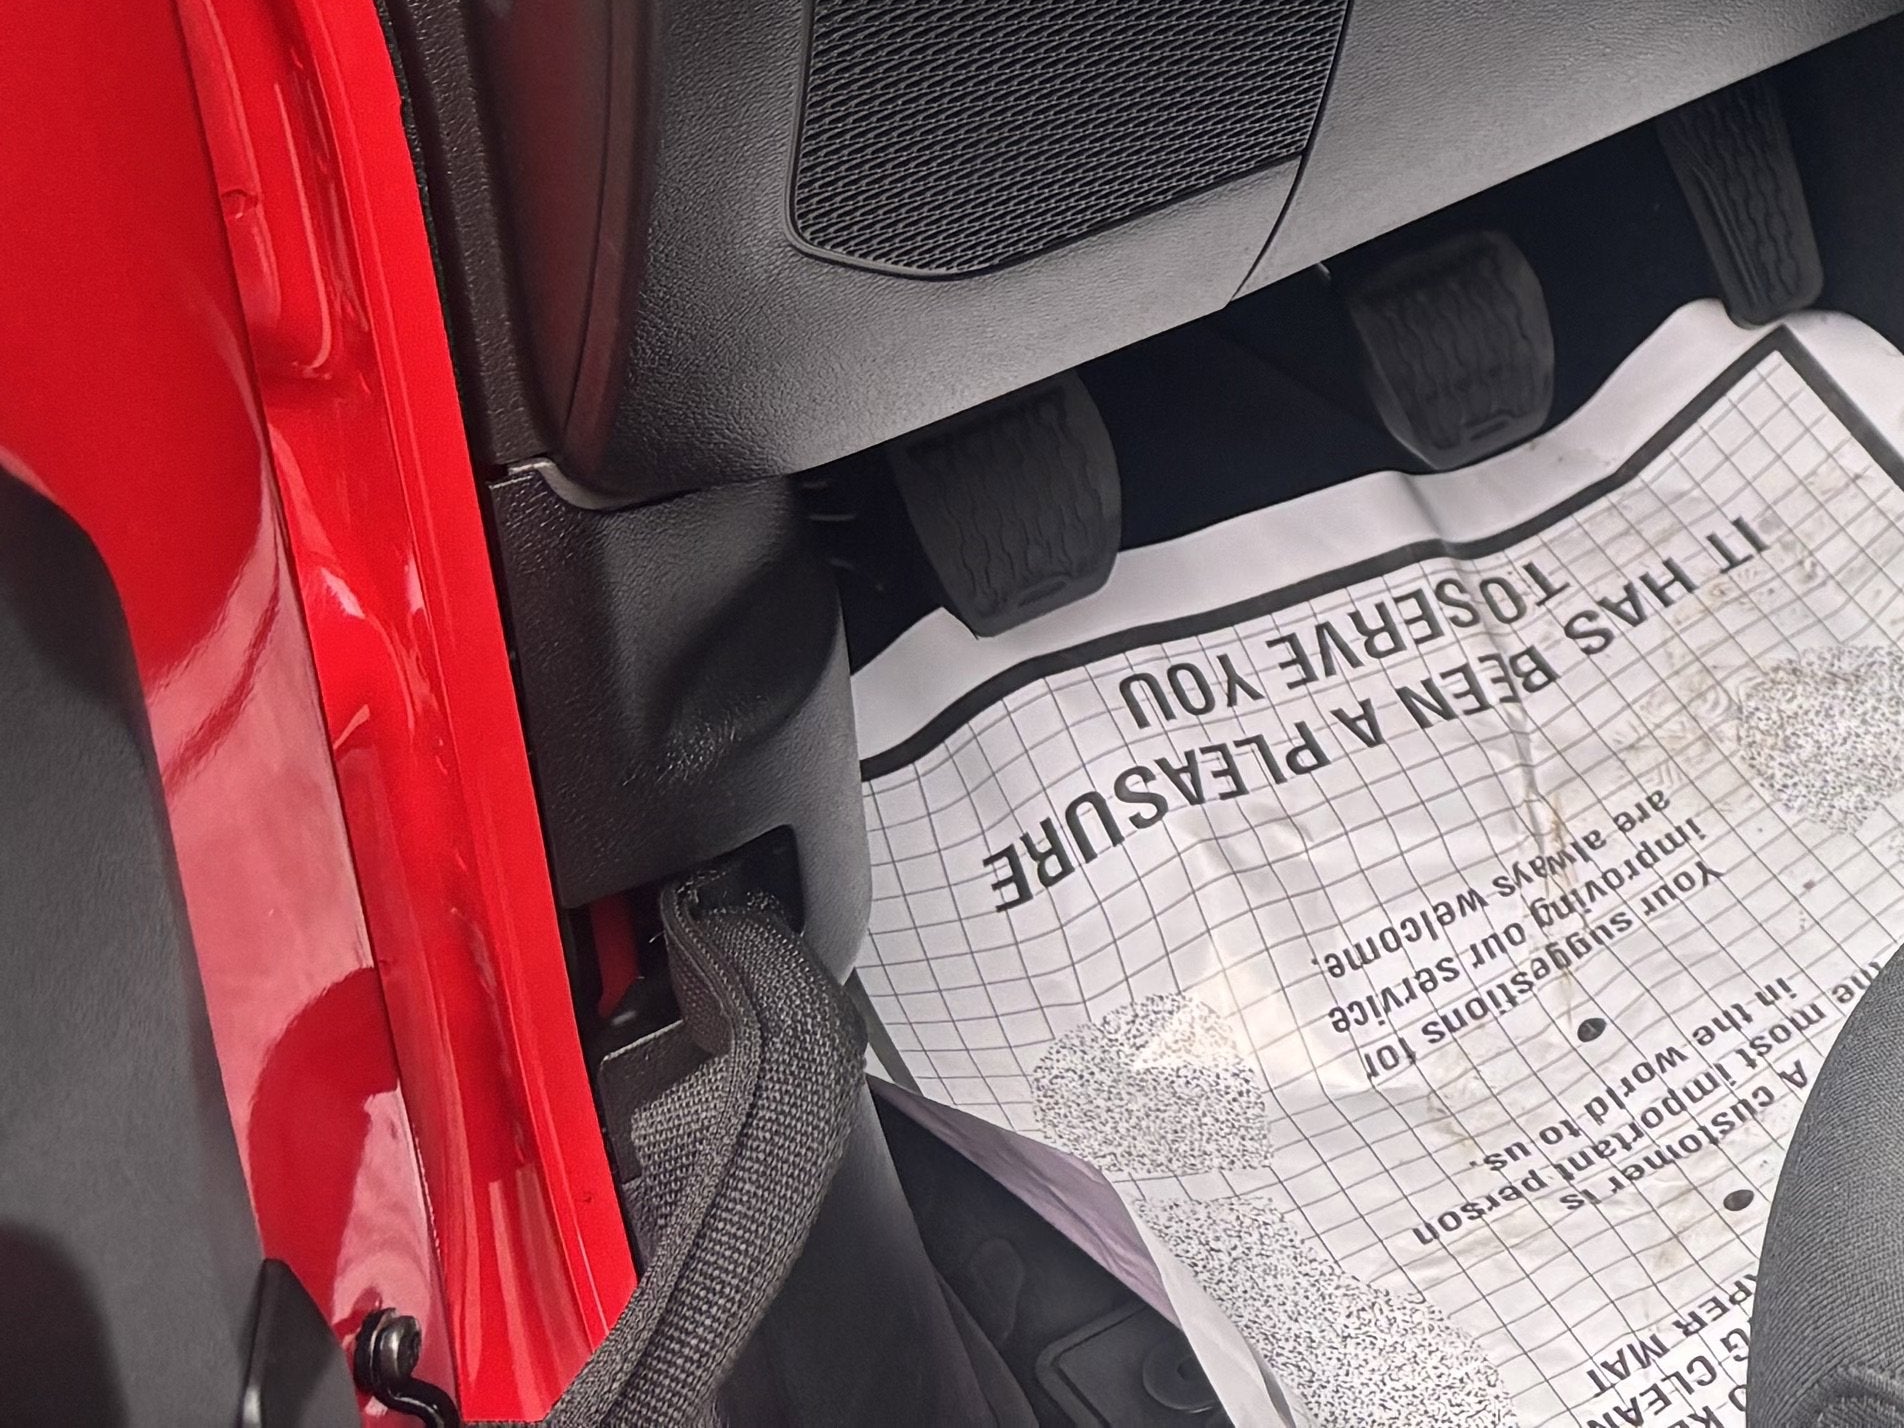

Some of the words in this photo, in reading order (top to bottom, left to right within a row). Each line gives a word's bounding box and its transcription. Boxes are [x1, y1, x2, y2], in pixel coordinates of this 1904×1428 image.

[1705, 516, 1771, 574] IT
[1563, 557, 1699, 655] HAS
[1119, 653, 1265, 729] YOU
[1395, 645, 1562, 729] BEEN
[1331, 698, 1387, 748] A
[982, 720, 1332, 913] PLEASURE
[1613, 789, 1671, 834] are
[1493, 830, 1607, 898] always
[1529, 818, 1707, 928] improving
[1643, 860, 1725, 917] Your
[1312, 886, 1489, 979] welcome.
[1471, 922, 1526, 969] our
[1327, 955, 1460, 1034] service
[1421, 910, 1634, 1045] suggestions
[1755, 977, 1798, 1008] in
[1363, 1037, 1417, 1080] for
[1691, 1003, 1753, 1047] the
[1736, 1003, 1827, 1070] most
[1583, 1046, 1691, 1126] world
[1779, 1059, 1809, 1089] A
[1538, 1118, 1582, 1147] to
[1555, 1062, 1737, 1184] important
[1611, 1084, 1777, 1195] customer
[1469, 1141, 1531, 1173] us.
[1410, 1168, 1546, 1245] person
[1586, 1334, 1671, 1397] MAT
